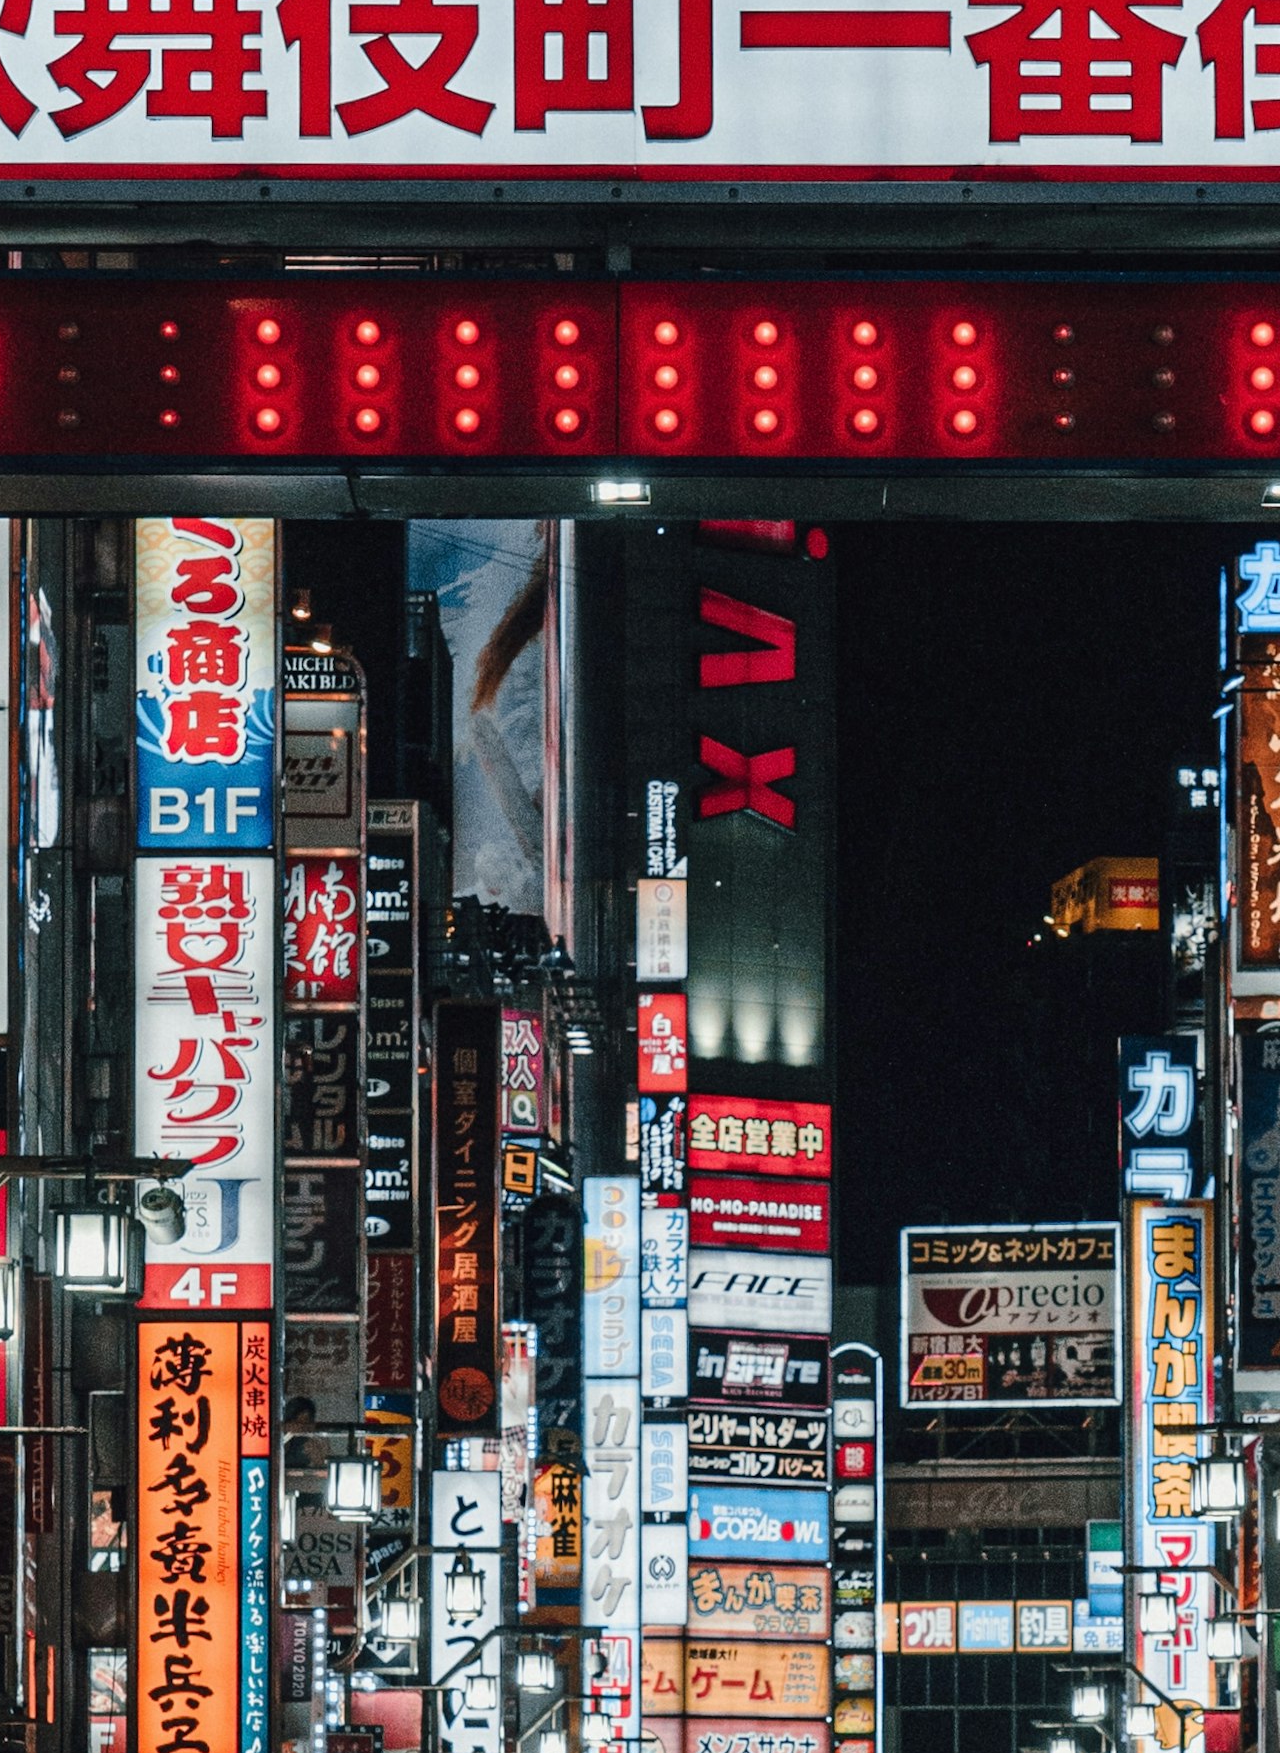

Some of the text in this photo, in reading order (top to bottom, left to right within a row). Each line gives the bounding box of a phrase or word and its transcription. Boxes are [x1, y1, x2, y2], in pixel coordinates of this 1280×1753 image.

[149, 787, 261, 835] B1F
[690, 1113, 824, 1160] 全店営業中
[452, 1046, 478, 1345] 個室ダイニング居酒屋
[665, 1211, 685, 1295] カラオケ
[911, 1236, 1114, 1264] コミック&ネットカフェ
[170, 1267, 238, 1307] 4F
[691, 1270, 825, 1298] FACE
[958, 1274, 1105, 1324] aprecio
[651, 1315, 674, 1389] SEGA
[241, 1334, 268, 1439] 炭火串焼
[650, 1430, 674, 1504] SEGA
[730, 1451, 776, 1478] ゴルフ
[551, 1472, 578, 1559] 麻雀
[592, 1392, 634, 1619] カラオケ
[691, 1568, 822, 1616] まんが喫茶
[963, 1610, 1010, 1646] Fishing
[1020, 1606, 1068, 1645] 釣具
[692, 1663, 775, 1701] ゲーム
